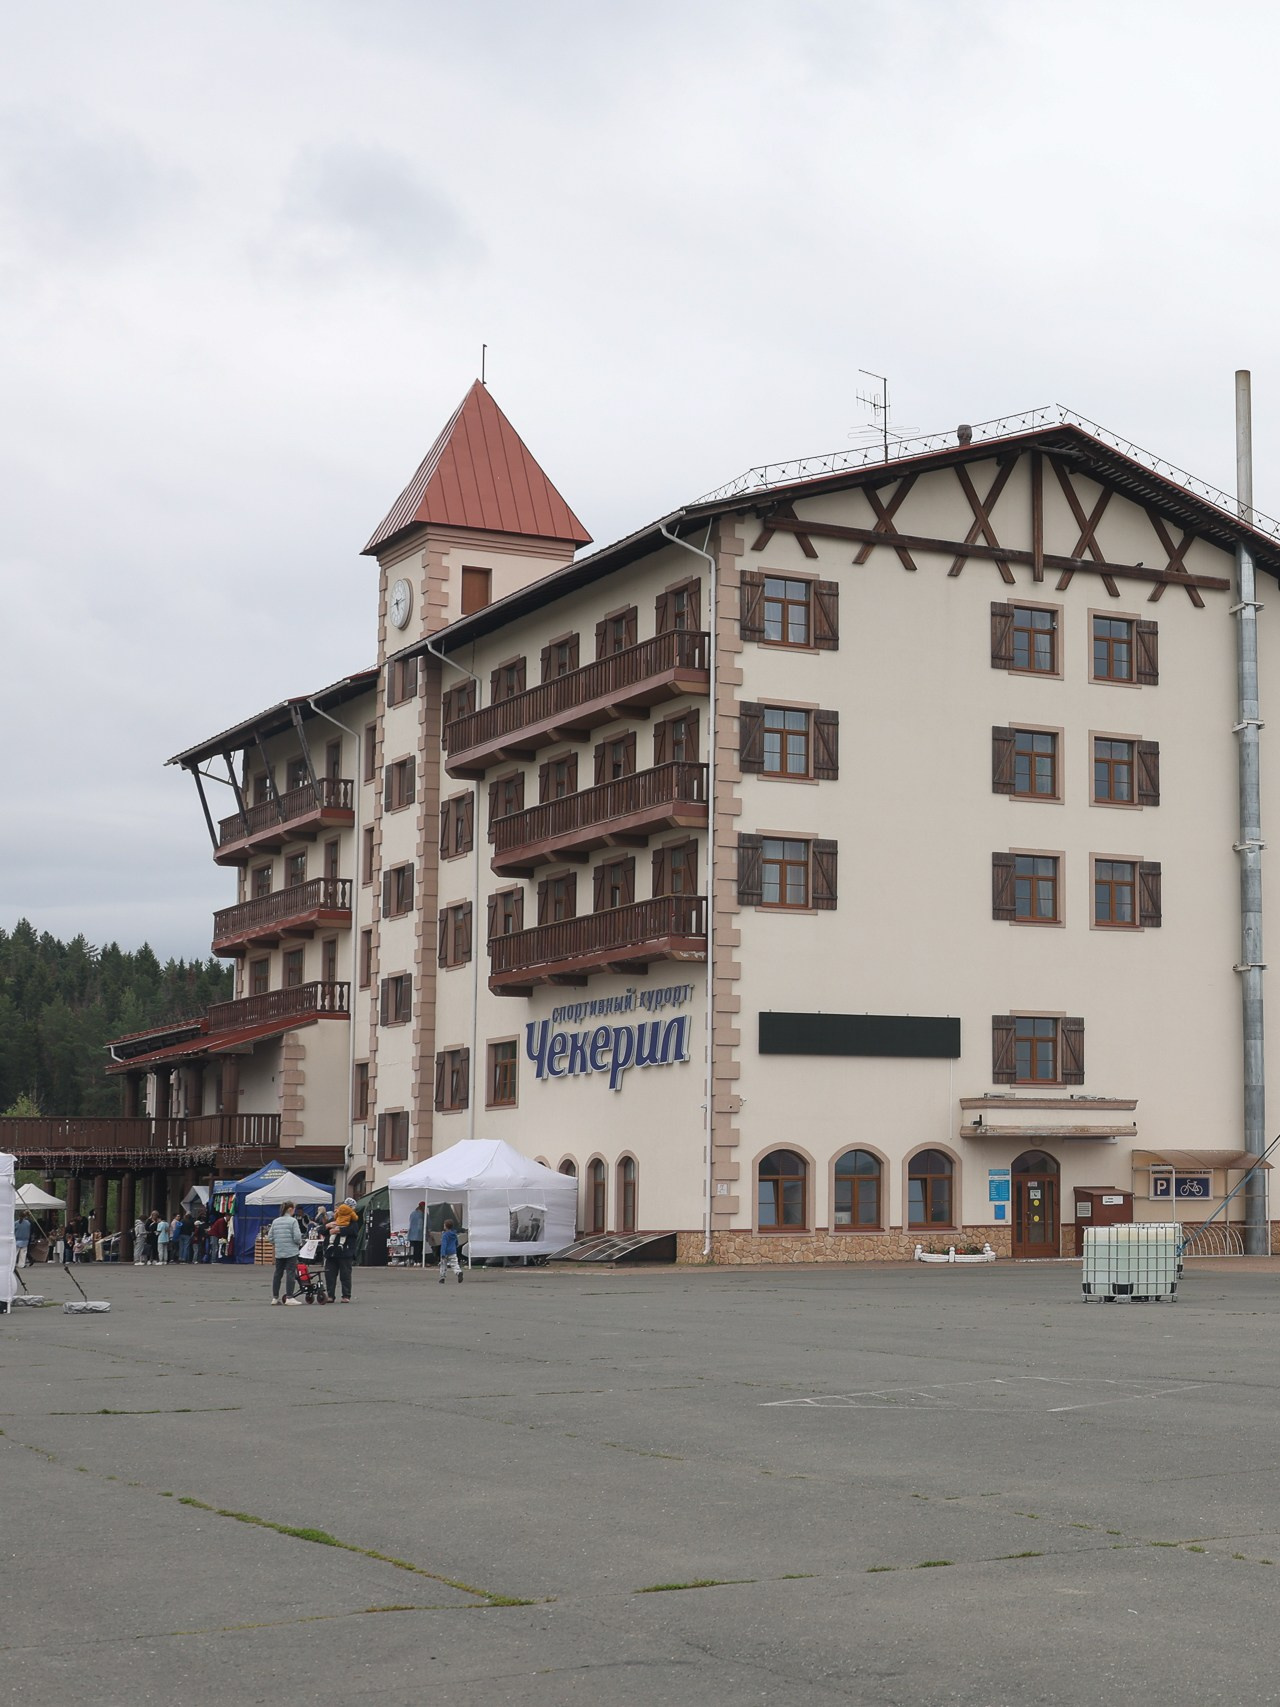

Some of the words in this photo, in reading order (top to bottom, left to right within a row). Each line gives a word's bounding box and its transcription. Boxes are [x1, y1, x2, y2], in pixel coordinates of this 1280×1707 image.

[552, 988, 636, 1025] спортивный
[639, 984, 695, 1012] курорт
[526, 1015, 692, 1090] Чекерил
